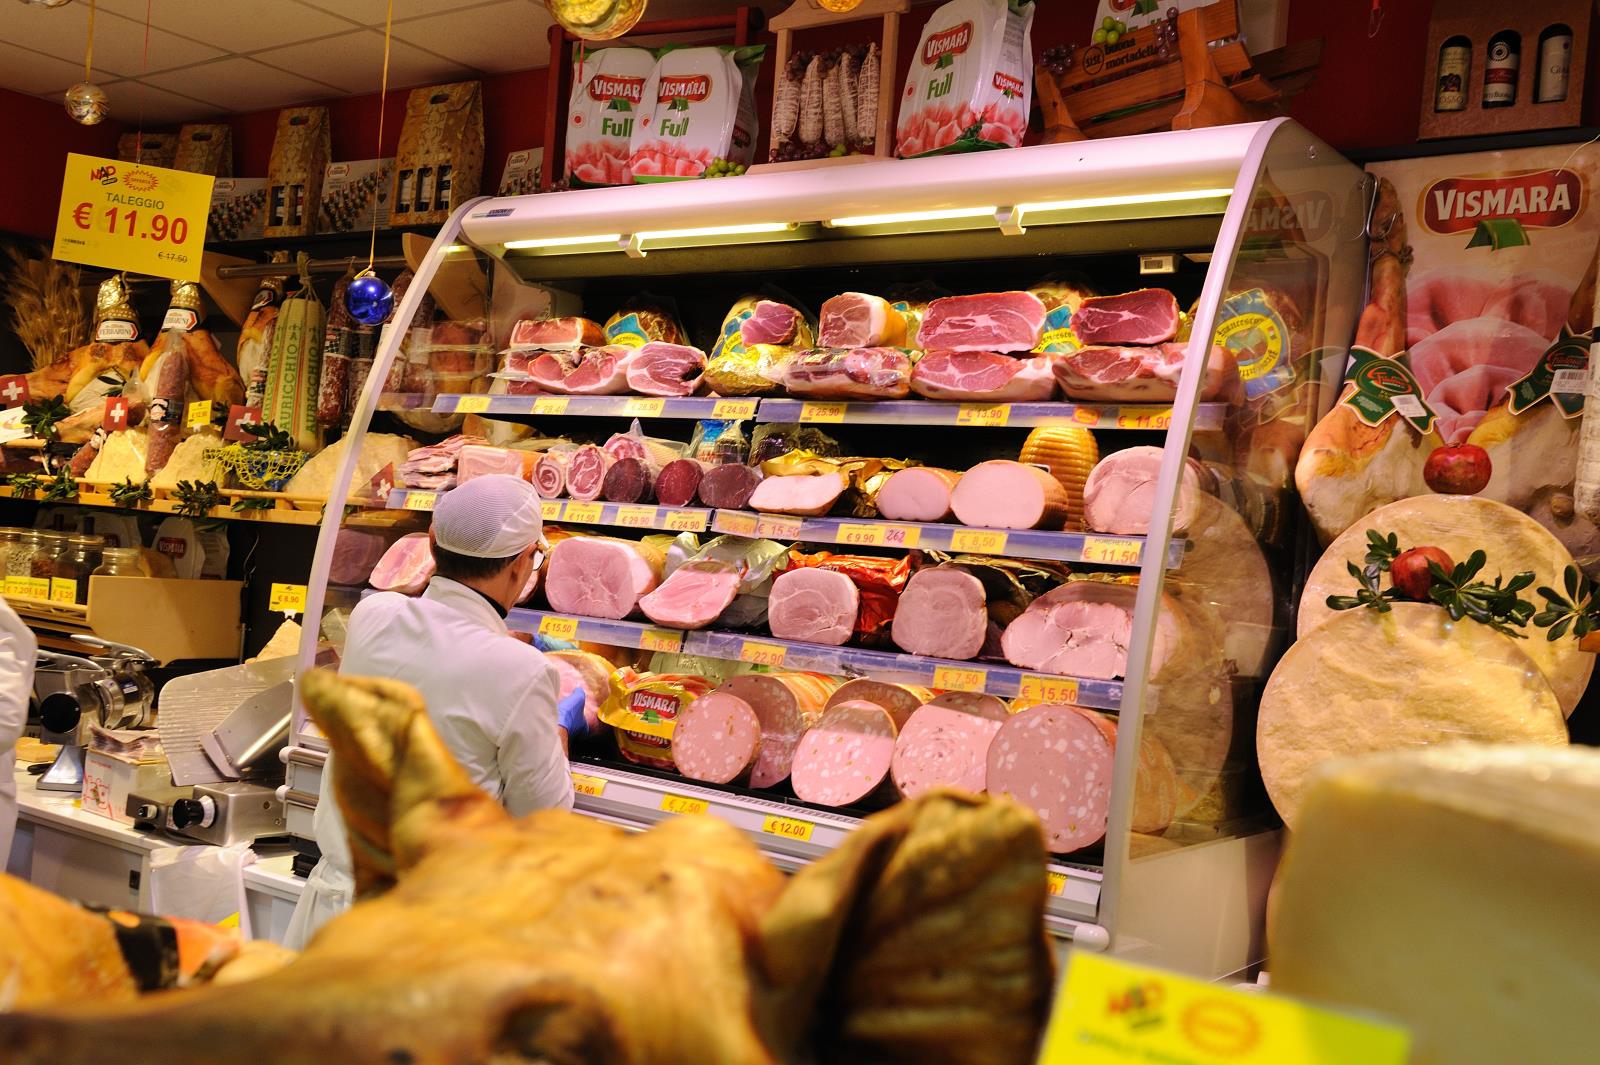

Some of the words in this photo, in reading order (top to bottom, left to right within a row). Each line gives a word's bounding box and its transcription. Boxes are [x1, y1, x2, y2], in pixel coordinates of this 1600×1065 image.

[927, 29, 968, 58] VISMARA
[927, 72, 954, 100] Full
[602, 117, 634, 137] Full
[660, 116, 689, 136] Full
[106, 192, 164, 210] TALEGGIO
[1434, 184, 1572, 221] VISMARA
[72, 202, 94, 230] €
[105, 207, 188, 245] 11.90
[279, 345, 298, 432] AURICCHIO
[728, 406, 748, 415] 24.90
[816, 408, 840, 416] 25.90
[1118, 416, 1126, 427] €
[678, 522, 700, 530] 24.90
[758, 524, 766, 534] €
[772, 525, 800, 538] 15.50
[847, 533, 853, 542] €
[855, 534, 874, 543] 9.90
[886, 530, 906, 544] 262
[1084, 547, 1092, 559] €
[1101, 549, 1138, 564] 11.50
[552, 623, 572, 632] 15.50
[740, 650, 748, 660] €
[753, 652, 784, 665] 22.90
[956, 673, 978, 684] 7.50
[1022, 686, 1031, 698] €
[1040, 687, 1076, 702] 15.50
[633, 692, 676, 714] VISMARA
[680, 801, 700, 814] 7.50
[772, 820, 779, 830] €
[780, 822, 806, 836] 12.00
